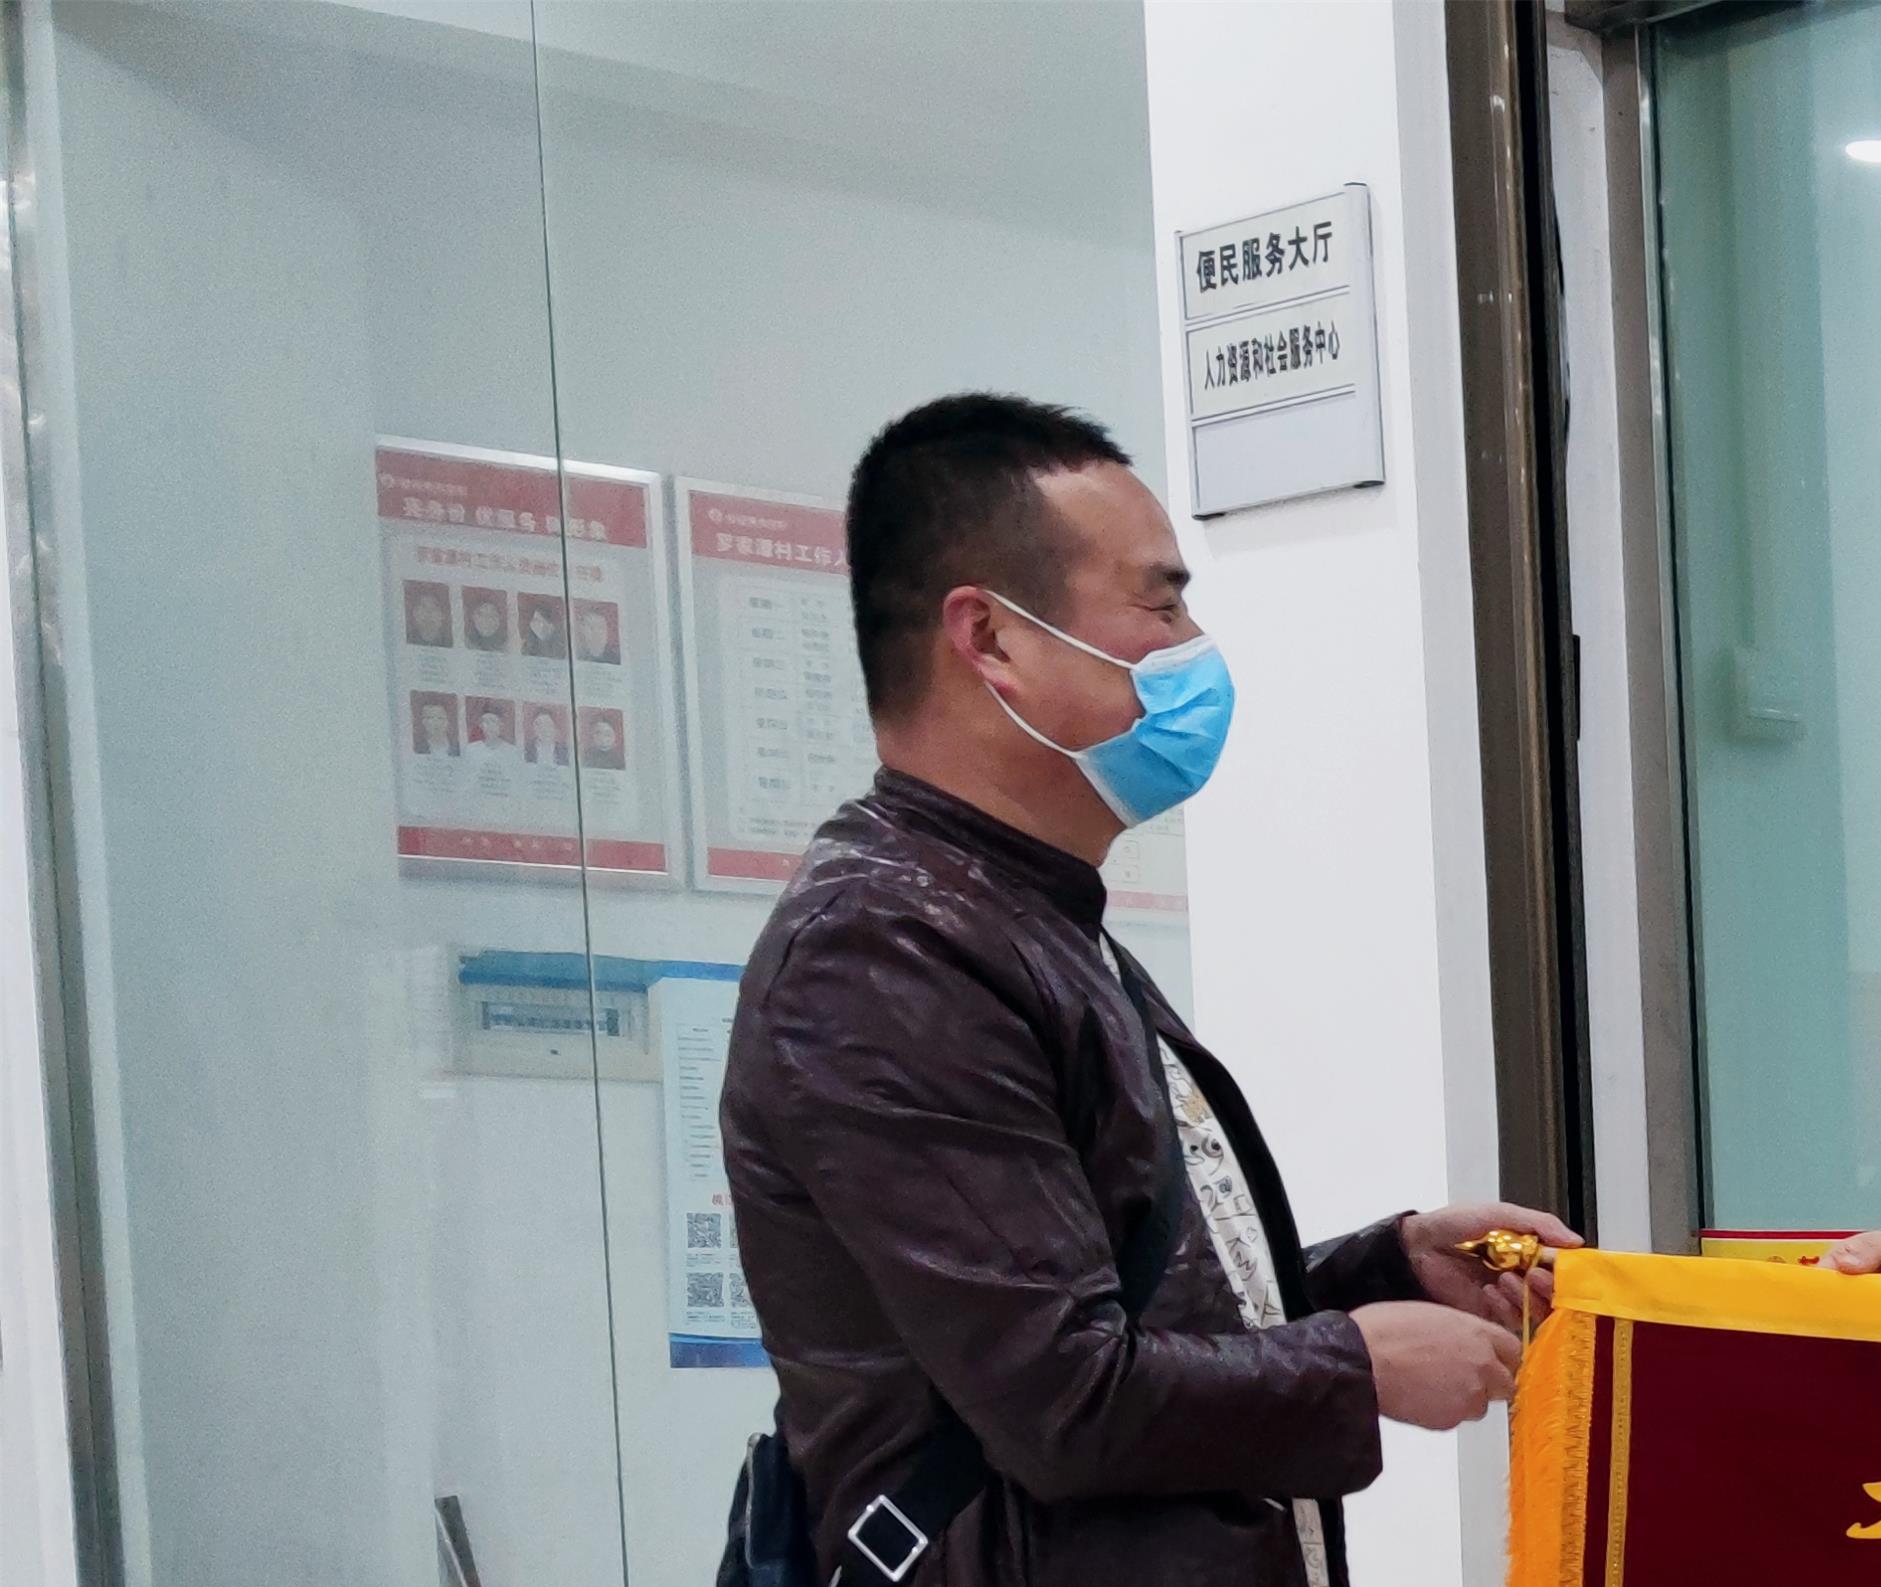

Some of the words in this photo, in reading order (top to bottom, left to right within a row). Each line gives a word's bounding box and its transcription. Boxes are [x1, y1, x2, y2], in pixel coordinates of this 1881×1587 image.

[1196, 221, 1333, 293] 便民服务大厅
[1204, 320, 1340, 391] 人力资源和社会服务中心
